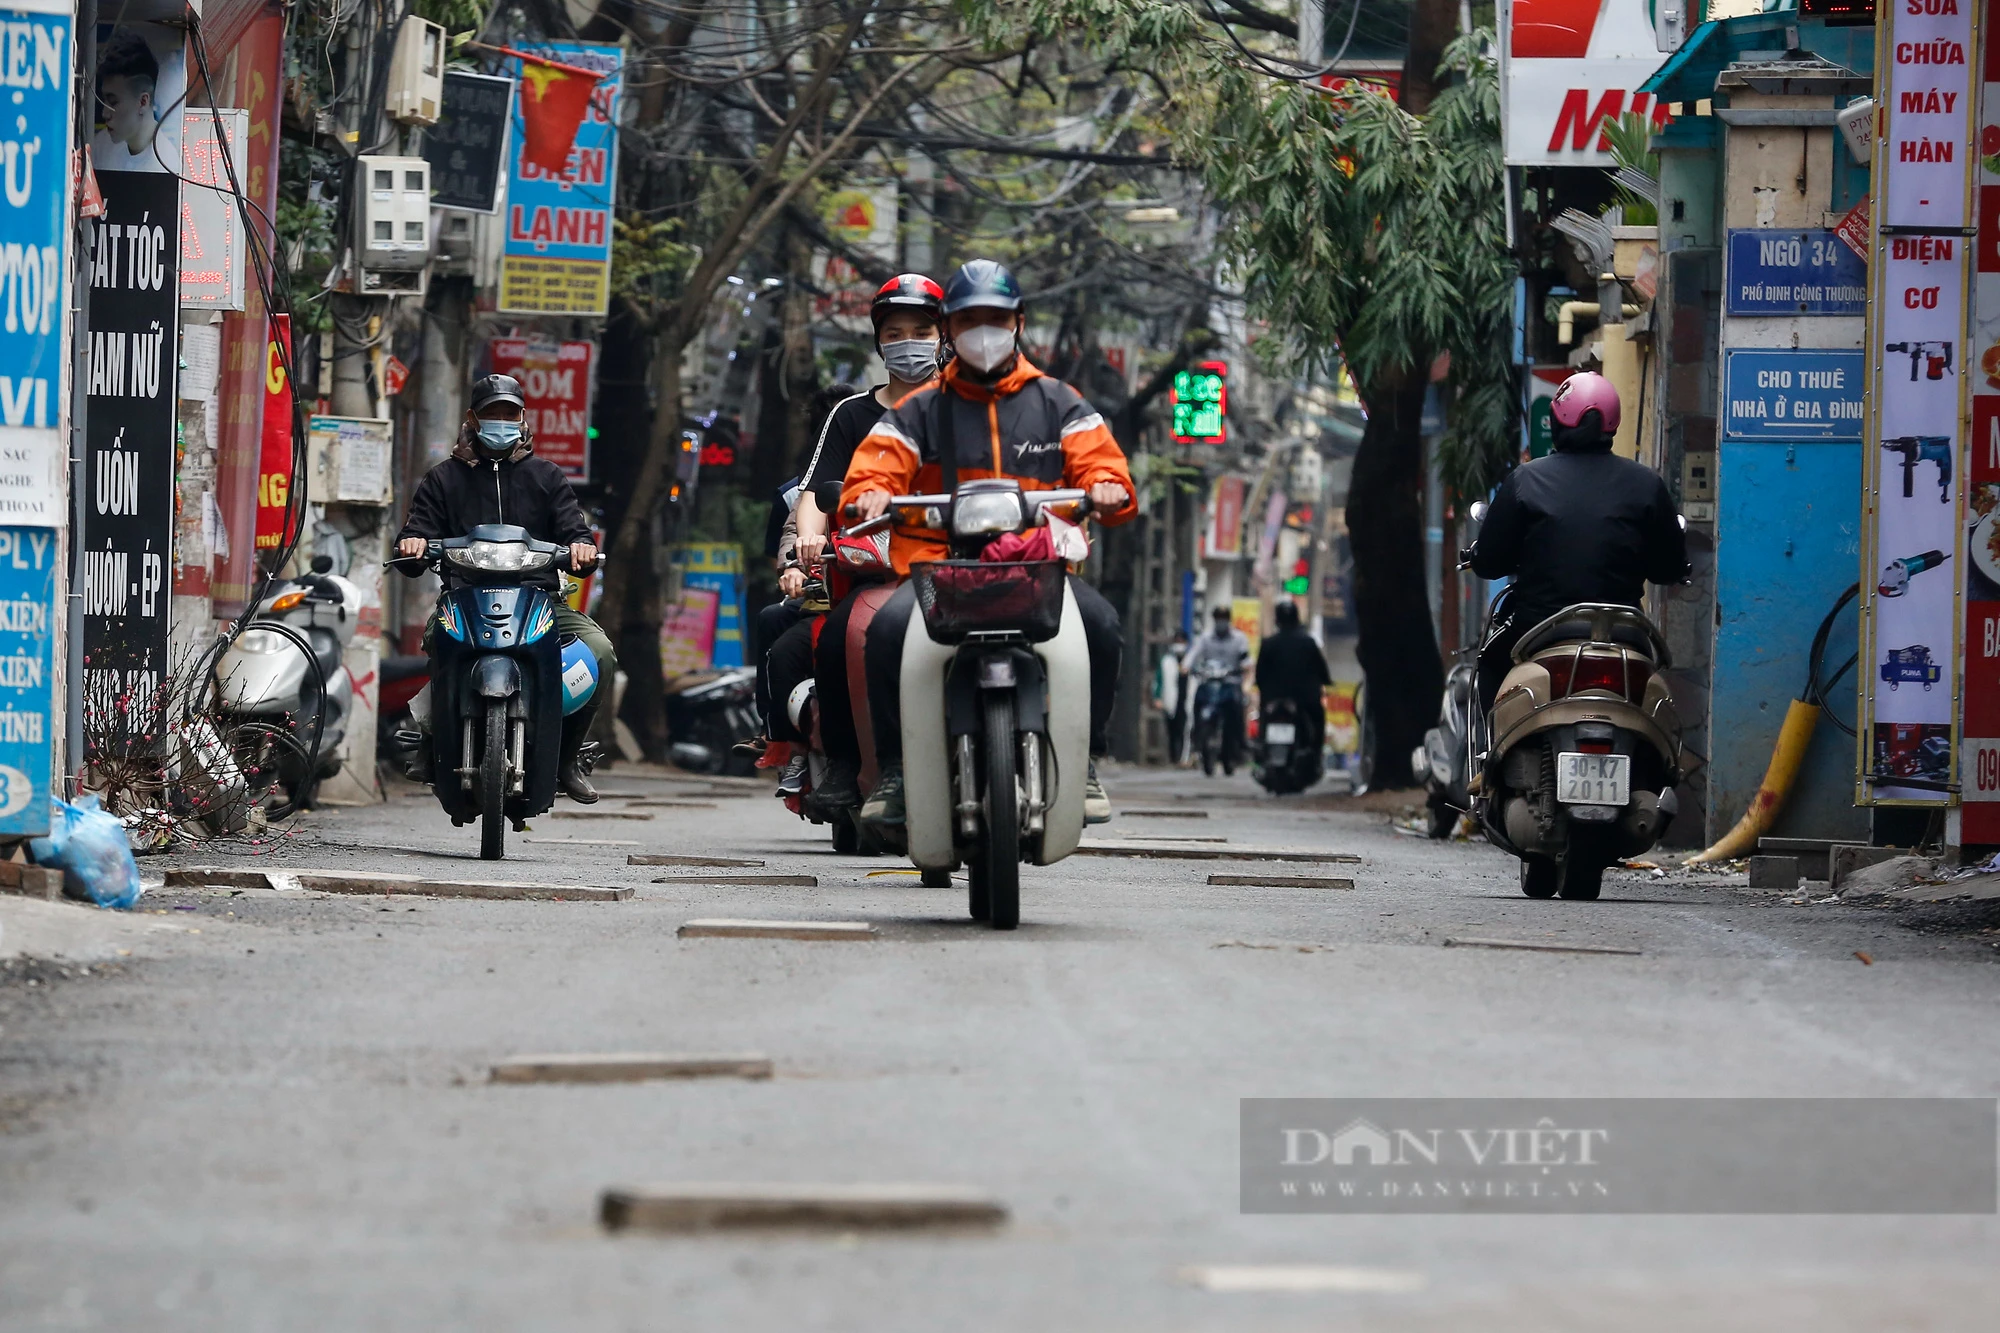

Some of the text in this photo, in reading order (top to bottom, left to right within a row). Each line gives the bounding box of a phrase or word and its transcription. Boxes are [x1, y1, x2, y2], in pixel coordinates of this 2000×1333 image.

[1896, 37, 1965, 65] CHỮA
[1900, 88, 1957, 114] MÁY
[1900, 137, 1953, 163] HÀN
[512, 206, 606, 250] LẠNH
[126, 211, 164, 290] TÓC
[1760, 236, 1800, 267] NGÕ
[1812, 240, 1837, 266] 34
[1892, 234, 1952, 265] ĐIỆN
[1742, 281, 1763, 301] PHỐ
[1765, 286, 1790, 304] ĐỊNH
[1794, 283, 1821, 301] CÔNG
[1904, 286, 1940, 309] CƠ
[131, 320, 163, 399] NỮ
[1757, 368, 1844, 389] CHO THUÊ
[1732, 397, 1768, 418] NHÀ
[1774, 395, 1787, 418] Ở
[1794, 401, 1822, 418] GIA
[96, 427, 139, 516] UỐN
[84, 537, 127, 631] HUỘM
[141, 538, 161, 617] ÉP
[1983, 616, 2000, 658] B
[571, 671, 588, 687] UBER
[1901, 669, 1922, 677] PUMA
[1568, 757, 1620, 779] 30-K7
[1977, 748, 2000, 791] 09
[1567, 780, 1618, 802] 2011
